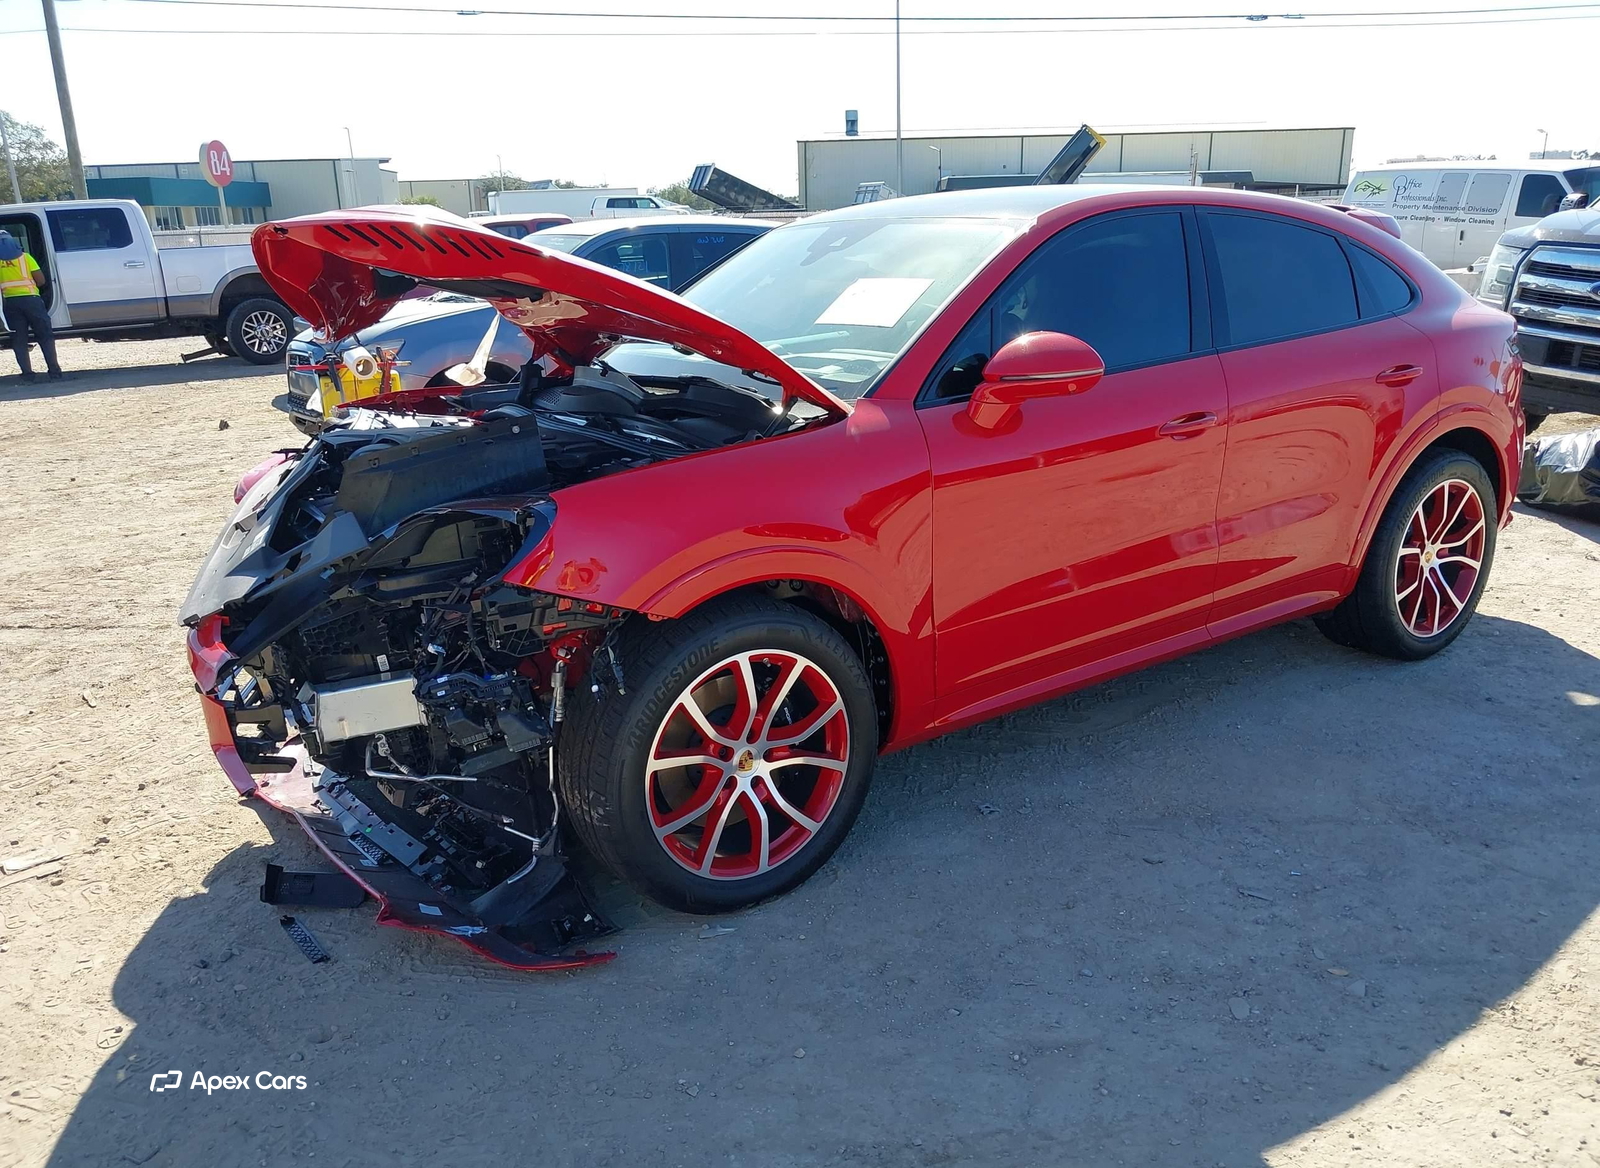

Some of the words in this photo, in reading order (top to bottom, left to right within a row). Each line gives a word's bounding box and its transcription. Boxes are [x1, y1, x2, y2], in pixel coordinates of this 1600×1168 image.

[210, 150, 230, 175] 84
[1392, 174, 1422, 191] Office
[1391, 203, 1420, 211] Property
[1467, 205, 1498, 214] Division
[1409, 214, 1436, 223] Cleaning
[1443, 215, 1467, 223] Window
[1468, 217, 1495, 226] Cleaning
